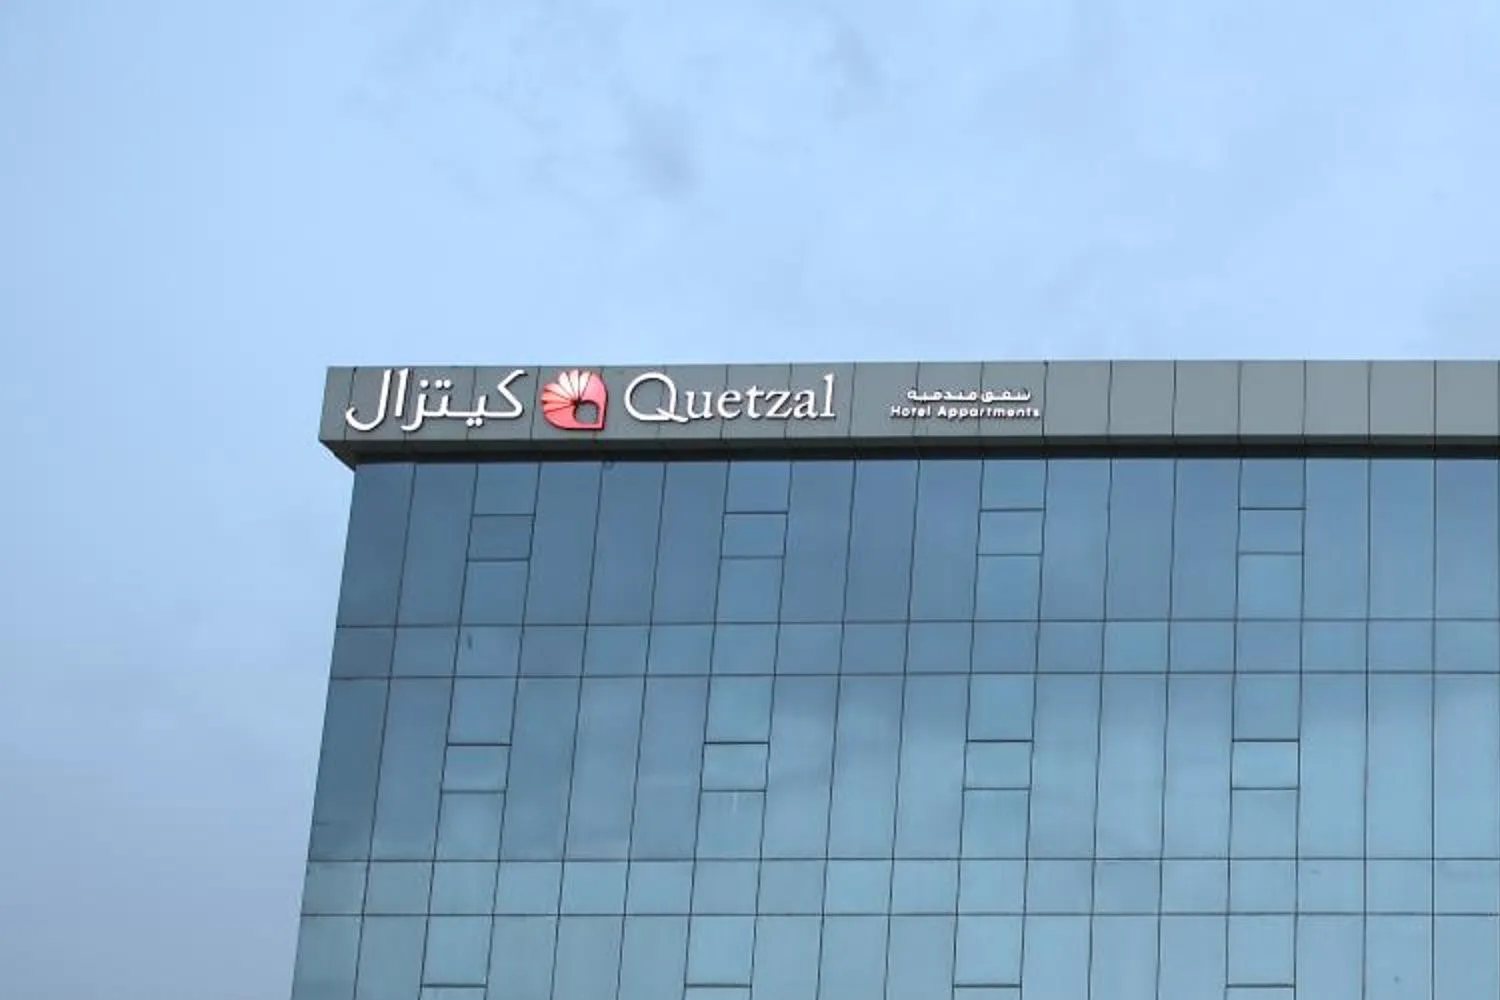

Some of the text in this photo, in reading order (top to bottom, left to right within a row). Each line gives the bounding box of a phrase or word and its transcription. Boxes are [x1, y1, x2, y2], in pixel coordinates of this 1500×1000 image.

[346, 368, 527, 431] كيتزال
[623, 371, 838, 423] Quetzal
[890, 405, 1040, 419] Hotel Appartments
